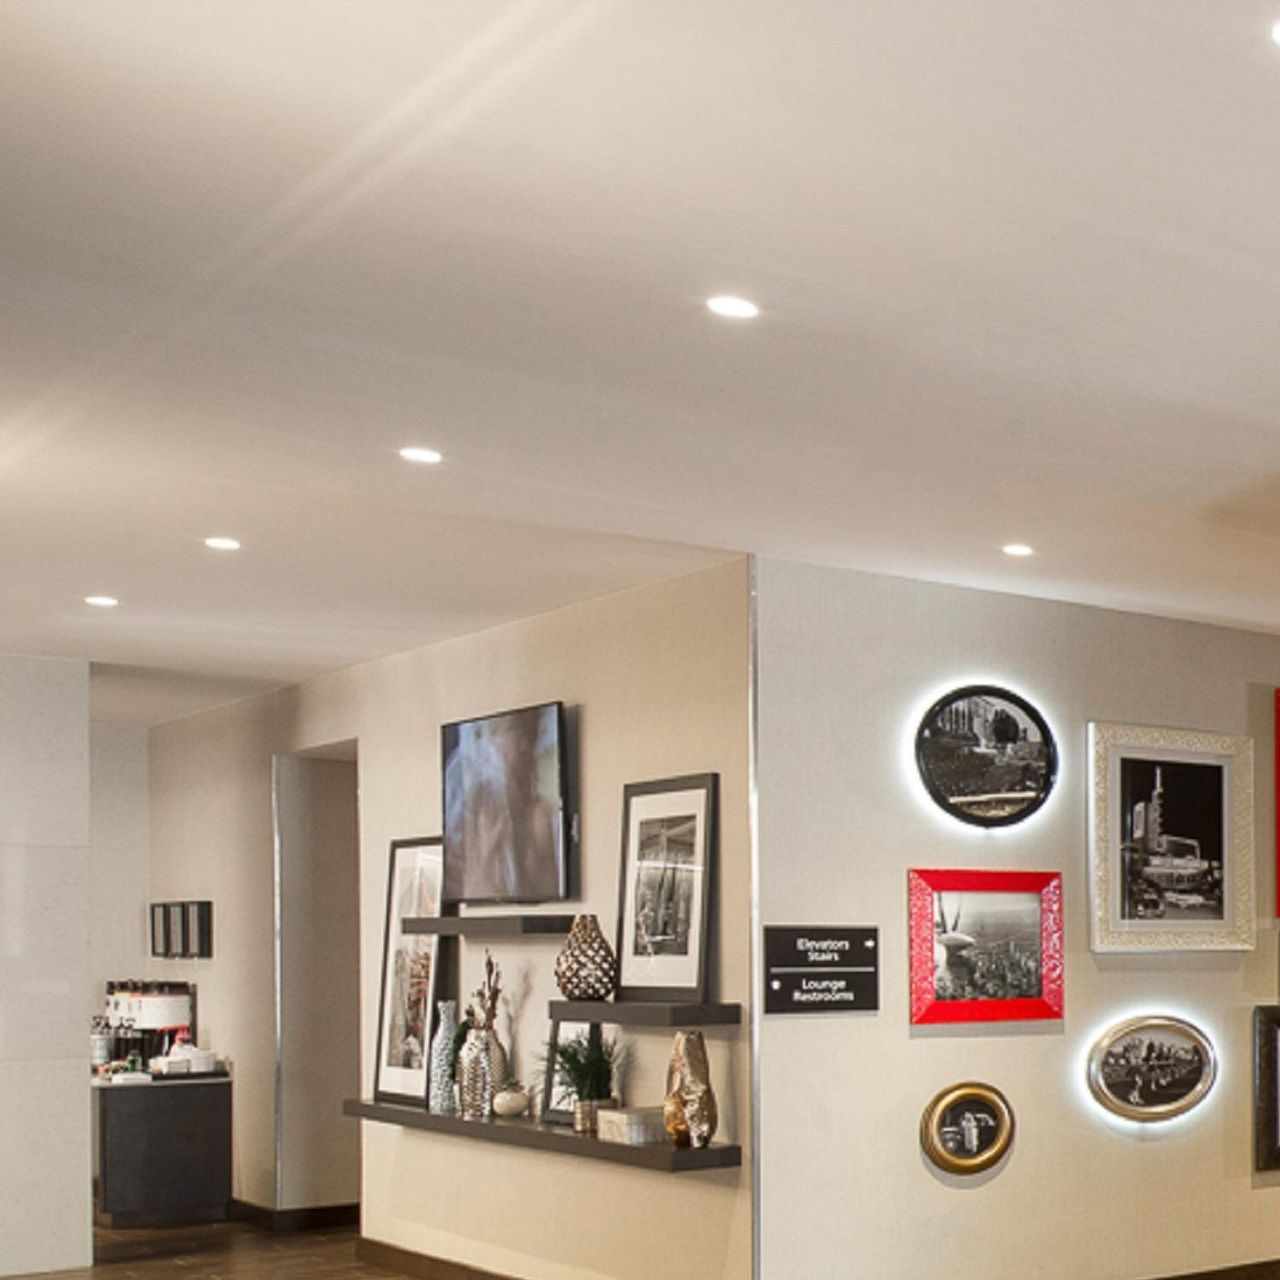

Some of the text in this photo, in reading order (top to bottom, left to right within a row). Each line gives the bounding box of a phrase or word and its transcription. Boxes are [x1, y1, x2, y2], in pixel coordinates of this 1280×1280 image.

[807, 950, 840, 962] Stairs
[802, 978, 846, 992] Lounge
[793, 990, 855, 1002] Restrooms
